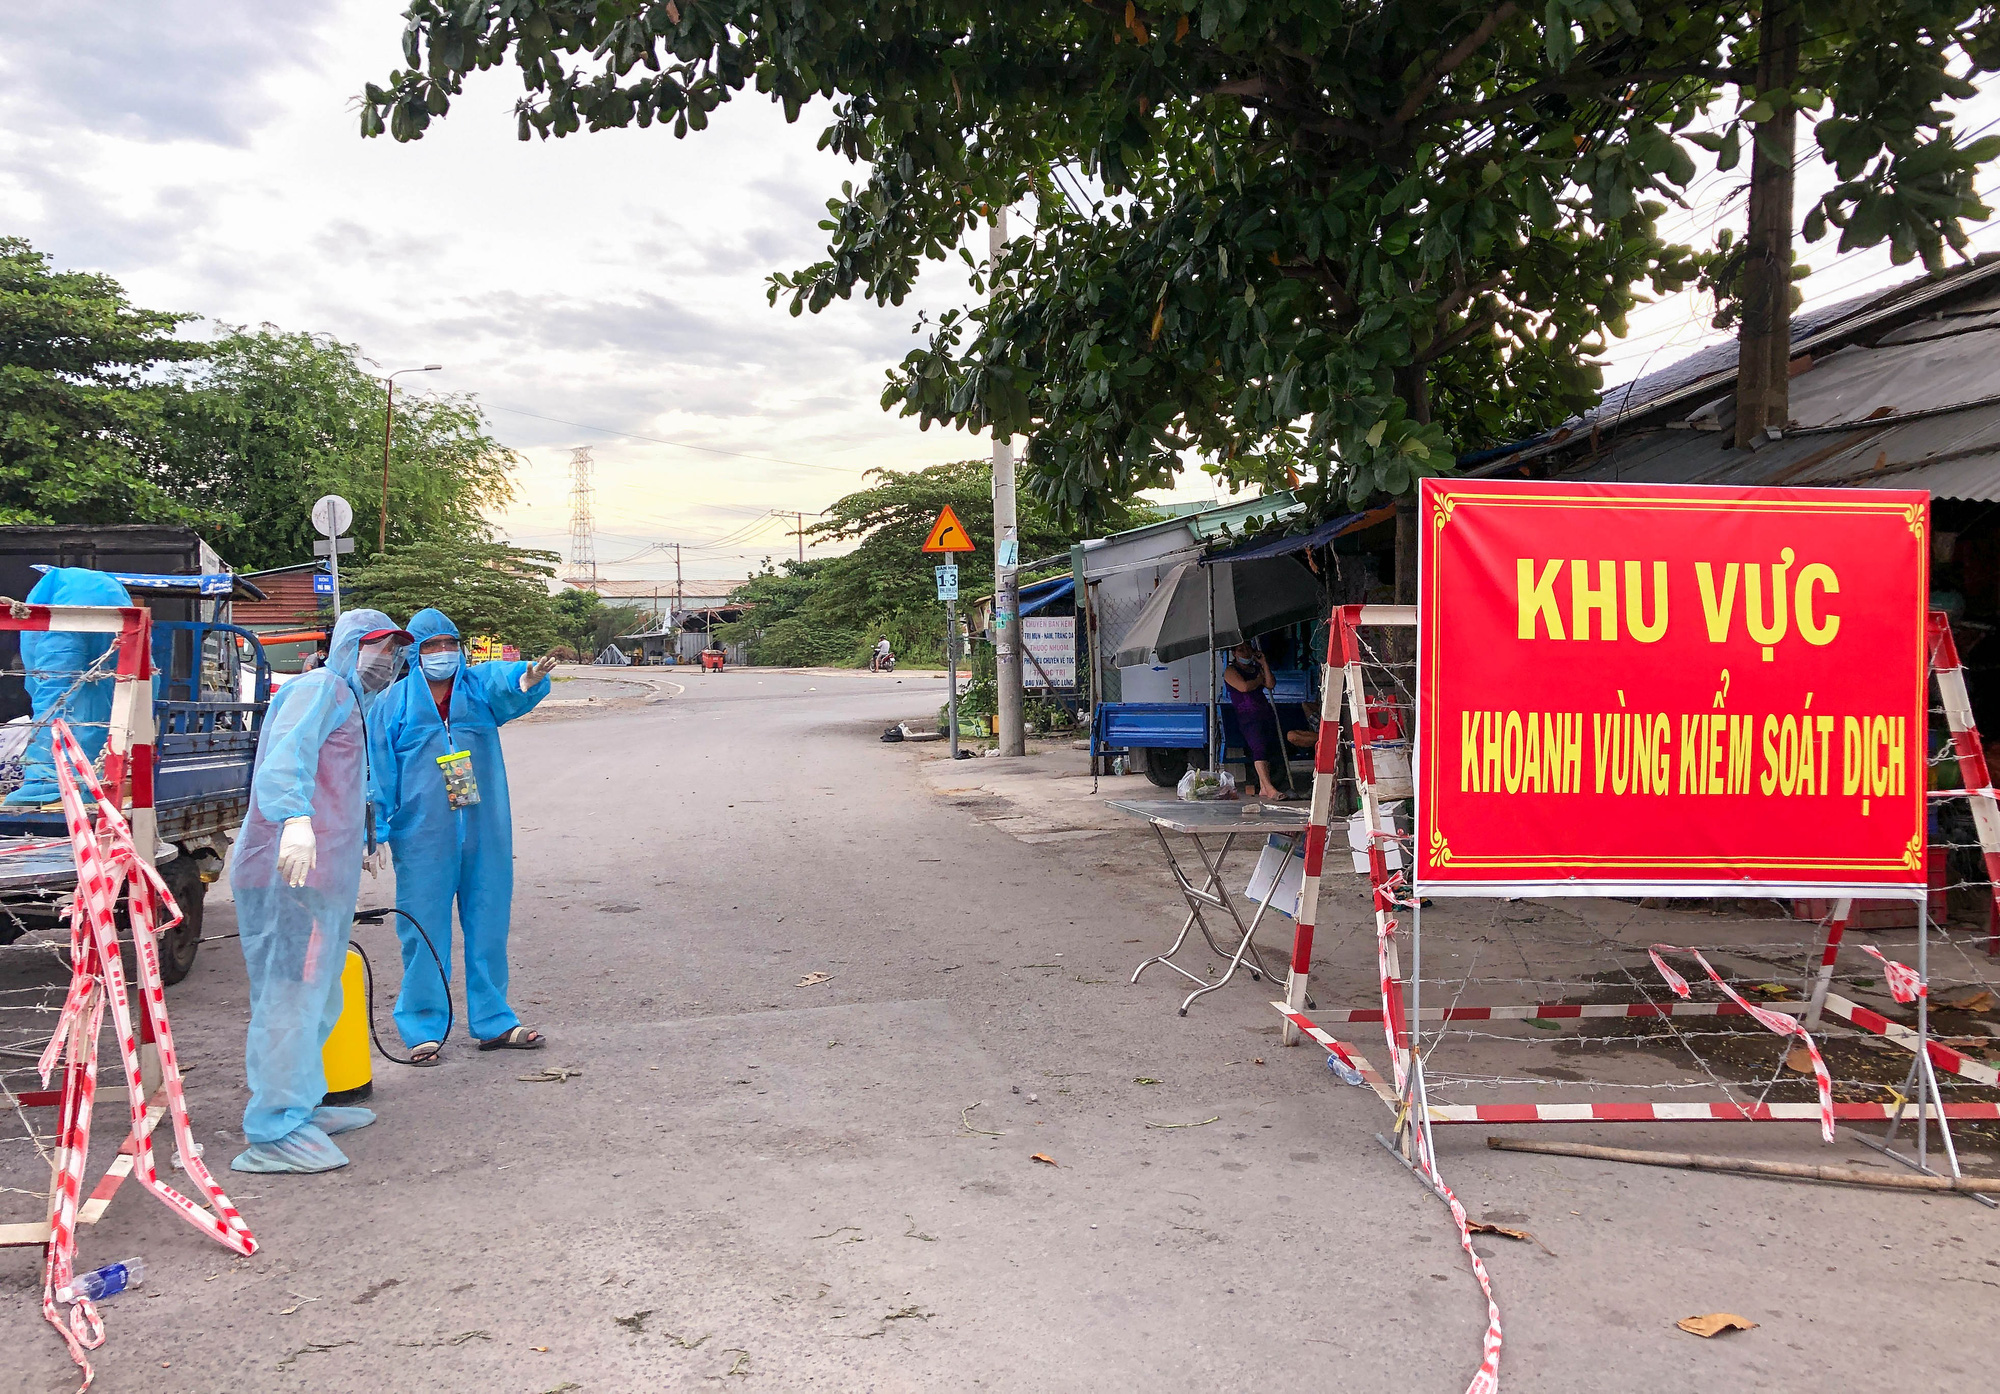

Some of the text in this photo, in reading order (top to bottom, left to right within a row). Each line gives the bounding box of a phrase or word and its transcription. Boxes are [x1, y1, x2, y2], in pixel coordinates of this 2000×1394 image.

[1516, 546, 1840, 662] KHU VỰC
[1461, 668, 1905, 816] KHOANH VÙNG KIỂM SOÁT DỊCH
